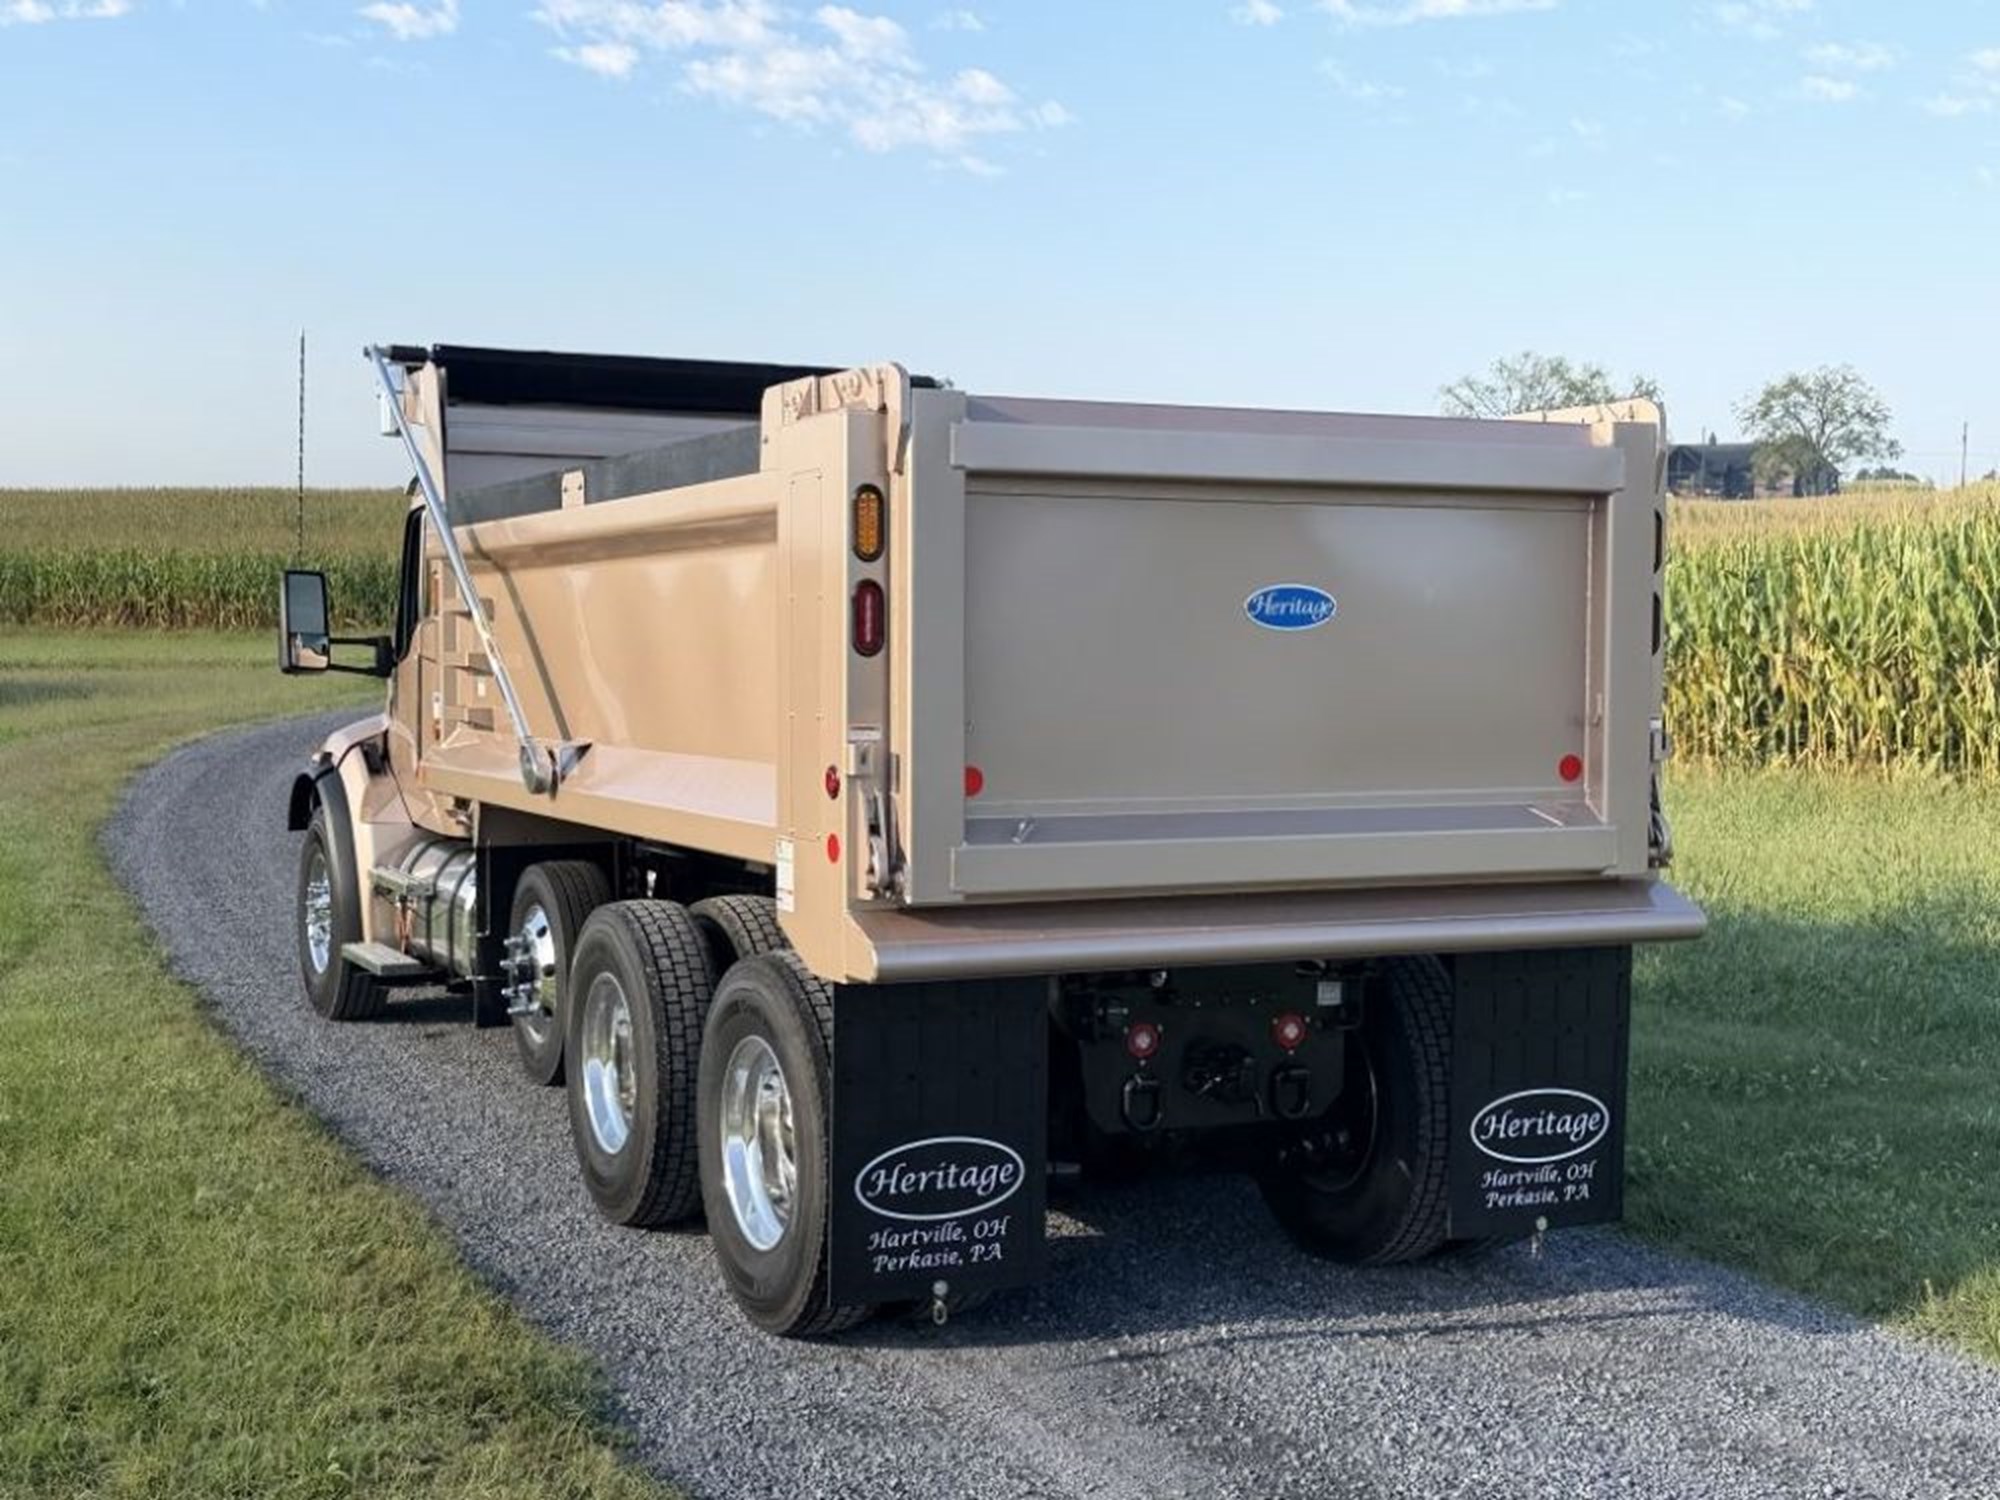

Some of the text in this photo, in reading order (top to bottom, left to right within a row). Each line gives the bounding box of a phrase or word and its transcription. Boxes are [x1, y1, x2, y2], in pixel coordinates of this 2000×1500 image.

[1252, 591, 1333, 621] Heritage
[1480, 1108, 1600, 1142] Heritage
[866, 1162, 1014, 1197] Heritage
[1481, 1160, 1597, 1188] Hartville, OH
[1486, 1183, 1590, 1208] Perkasie, PA
[868, 1216, 1011, 1250] Hartville, OH
[874, 1242, 1002, 1272] Perkasie, PA
